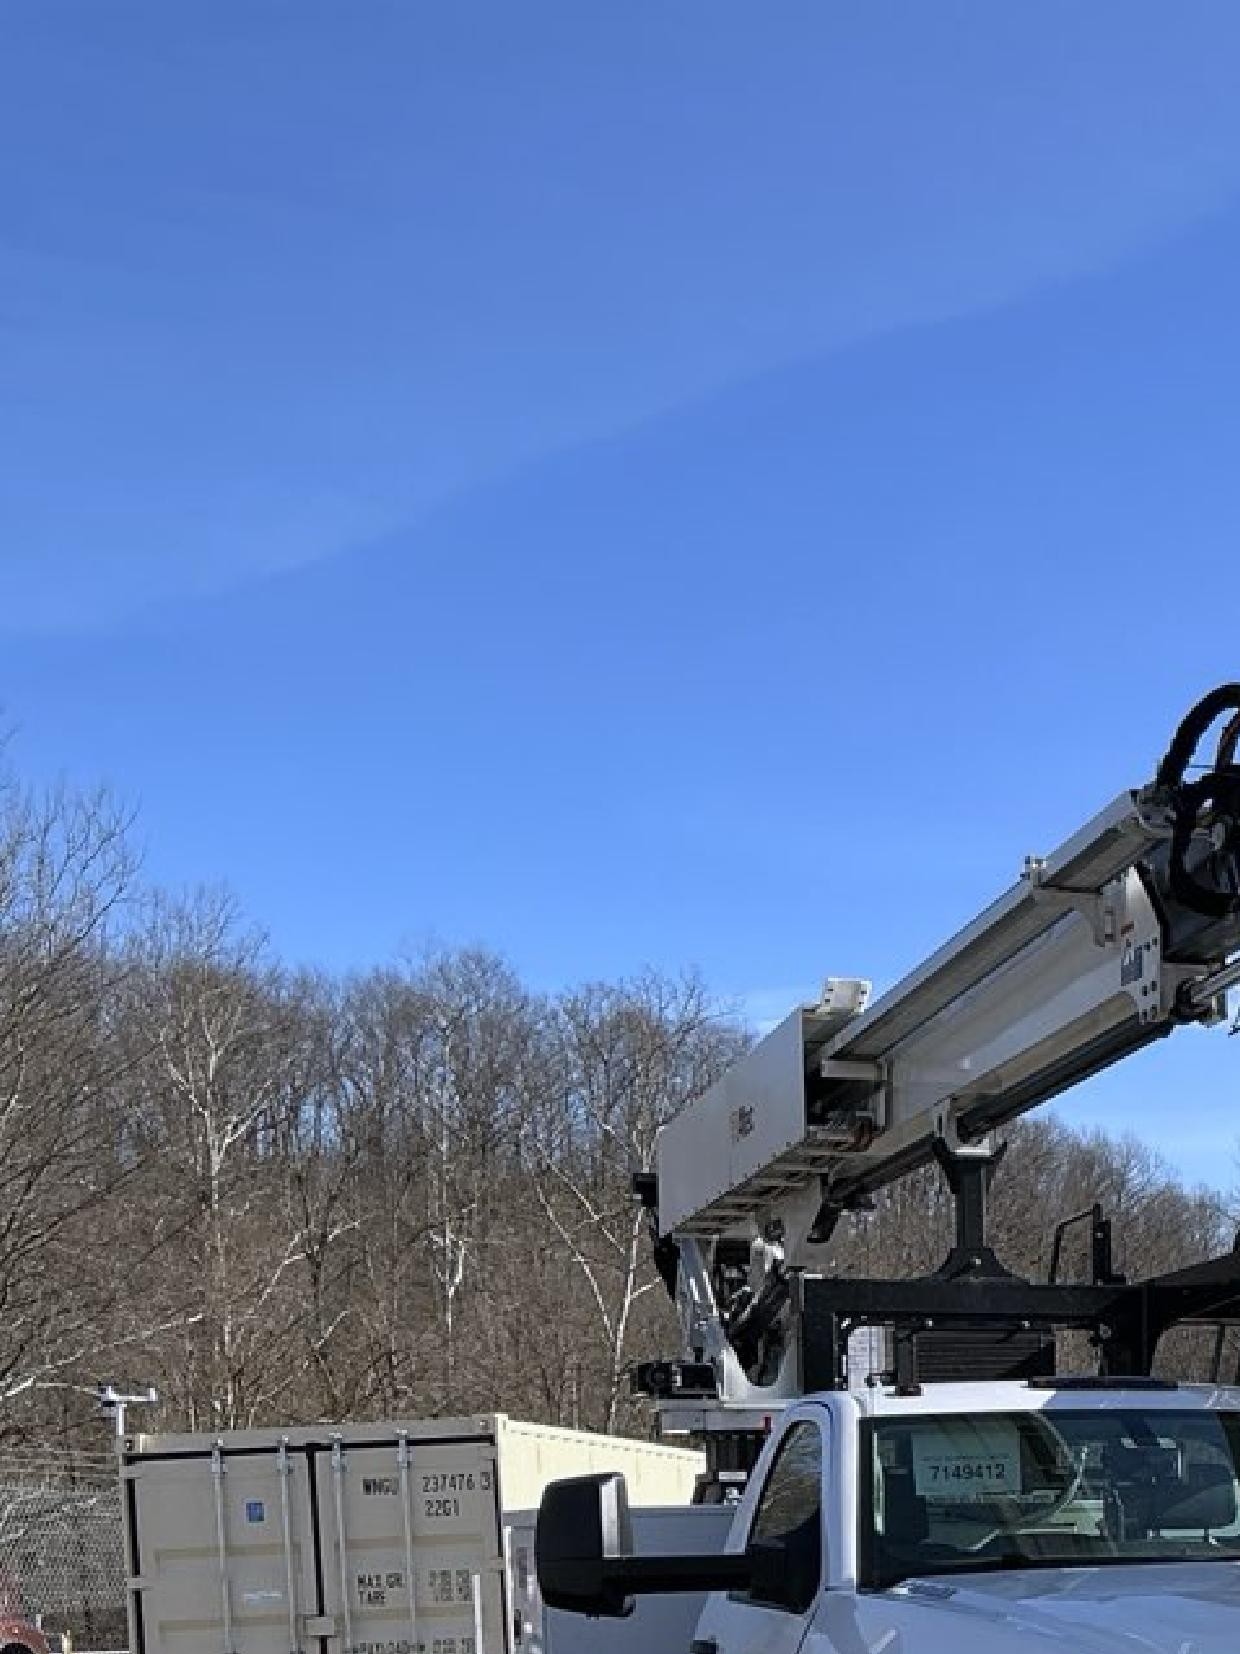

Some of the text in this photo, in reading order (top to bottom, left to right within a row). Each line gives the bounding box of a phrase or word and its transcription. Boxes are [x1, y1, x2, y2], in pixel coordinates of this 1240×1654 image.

[927, 1463, 1006, 1481] 7149412
[422, 1473, 476, 1493] 237476
[424, 1499, 460, 1517] 22G1
